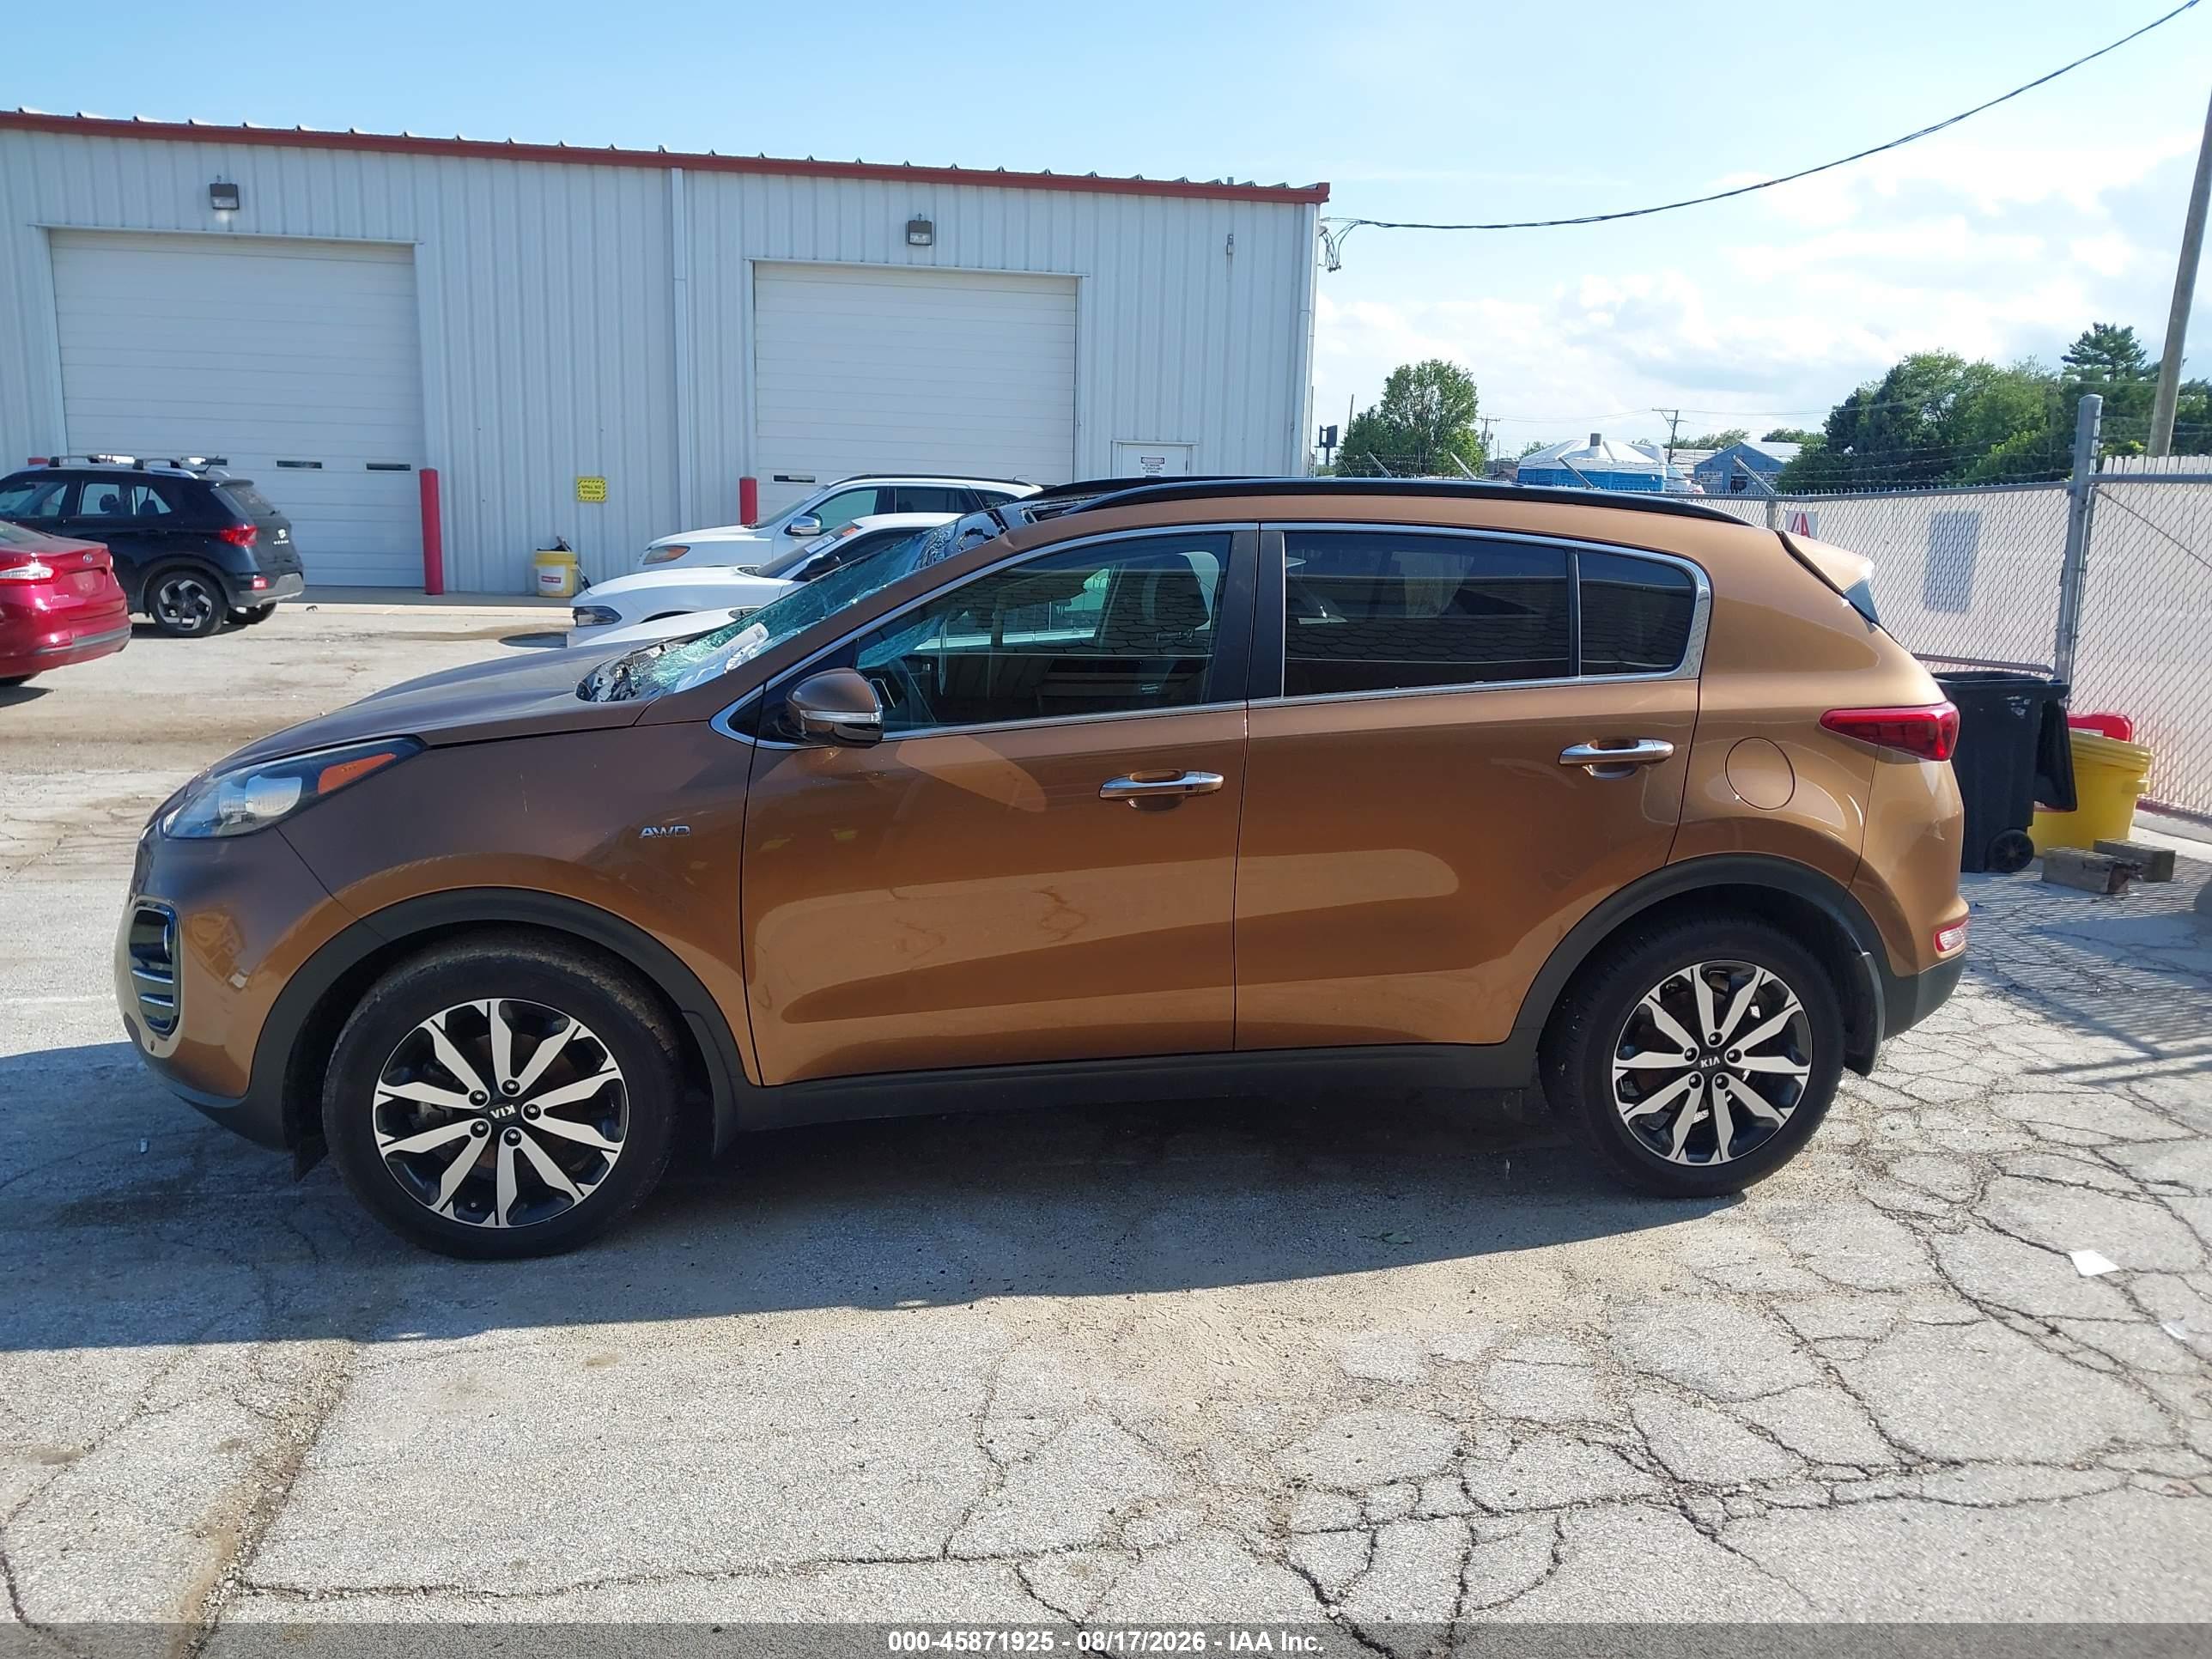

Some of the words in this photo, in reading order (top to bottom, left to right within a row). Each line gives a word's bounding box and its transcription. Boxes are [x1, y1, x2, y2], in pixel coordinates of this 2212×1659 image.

[639, 825, 690, 838] AWD
[1700, 1056, 1720, 1067] KIA
[489, 1104, 516, 1118] KIA
